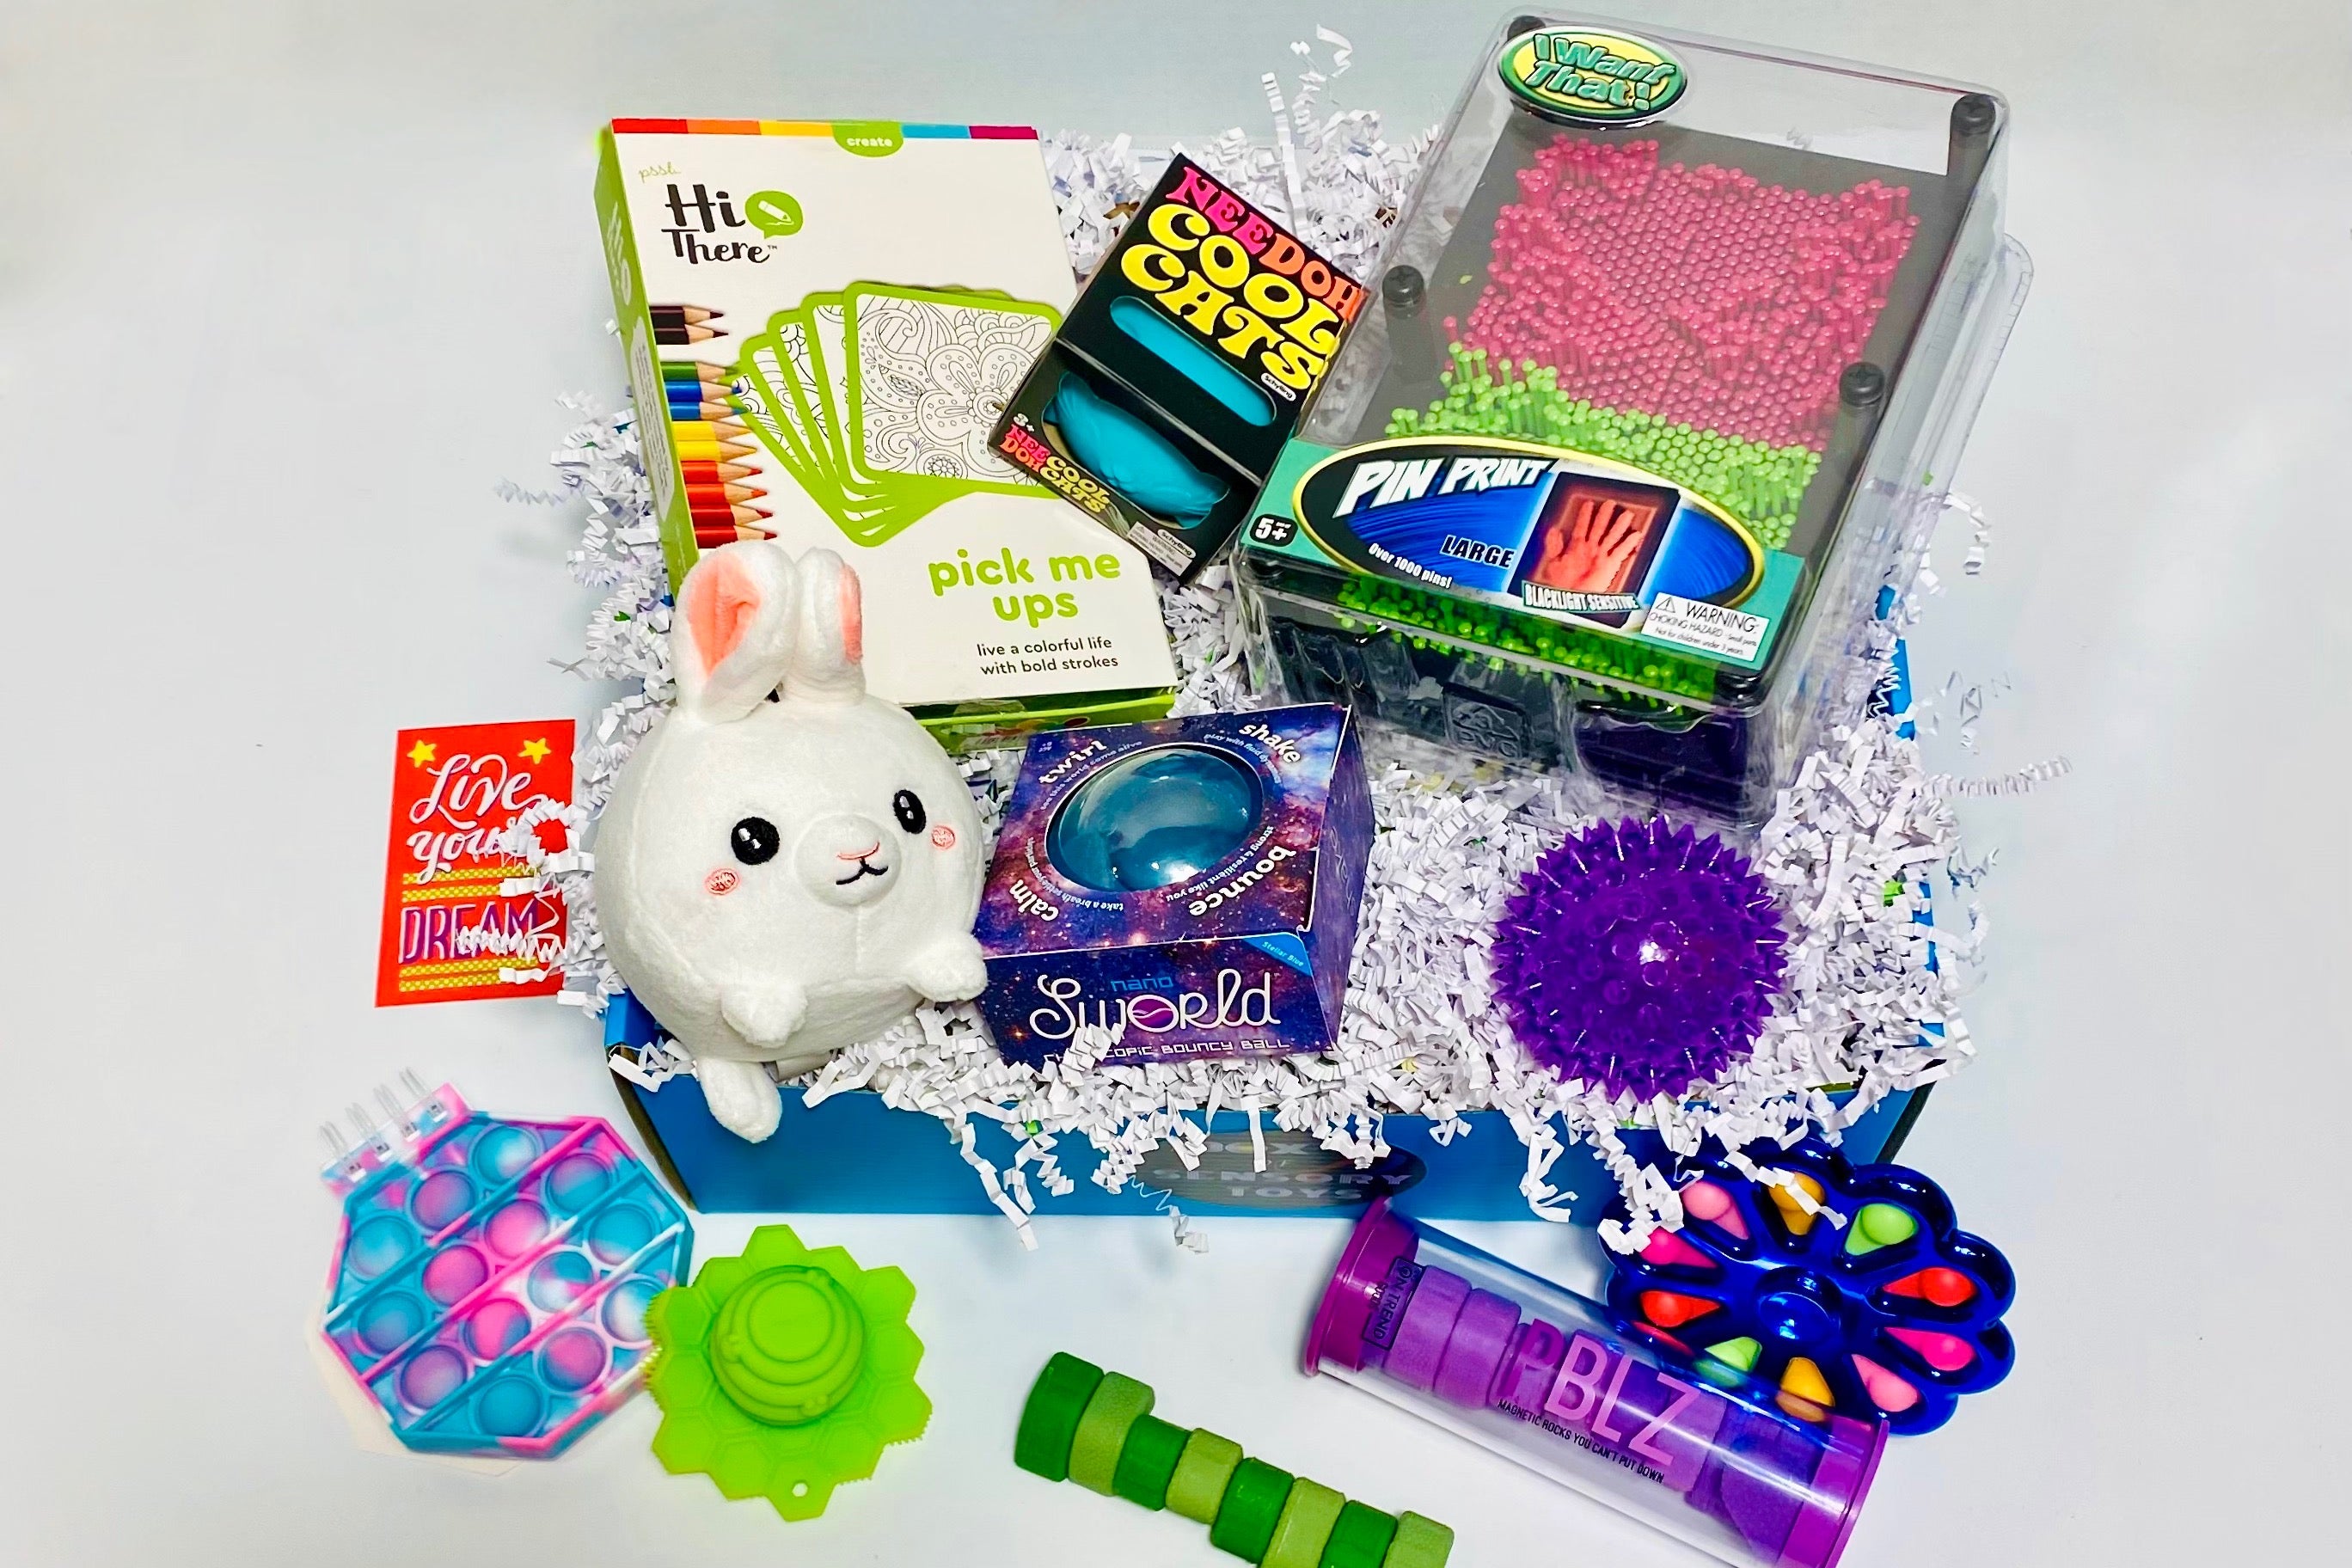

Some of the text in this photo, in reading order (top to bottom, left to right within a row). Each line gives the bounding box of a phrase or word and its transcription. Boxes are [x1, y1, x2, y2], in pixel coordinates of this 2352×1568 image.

[1533, 34, 1676, 85] I Want
[1524, 60, 1651, 111] That!
[846, 138, 893, 147] create
[665, 184, 745, 233] Hi
[1148, 204, 1340, 355] COOL
[1121, 244, 1324, 389] CATS
[1014, 413, 1035, 432] 3+
[999, 438, 1044, 473] DOH
[1039, 467, 1106, 513] CATS
[1046, 456, 1110, 505] COOL
[1332, 457, 1553, 518] PIN PRINT
[1369, 542, 1453, 589] Over 1000 pins!
[1440, 535, 1516, 570] LARGE
[928, 548, 1121, 597] pick me
[993, 592, 1079, 628] ups
[1525, 584, 1640, 611] BLACKLIGHT SENSITIVE
[1649, 612, 1688, 629] CHOKING
[1689, 622, 1723, 637] HAZARD
[1677, 632, 1701, 644] children
[1702, 640, 1720, 650] under
[977, 636, 1113, 657] live a colorful life
[980, 655, 1119, 676] with bold strokes
[1118, 741, 1142, 753] alive
[1238, 724, 1301, 763] shake
[1038, 740, 1107, 784] twirl
[409, 754, 548, 830] Live
[1249, 825, 1275, 852] strong
[1188, 845, 1297, 916] bounce
[1207, 855, 1248, 885] resilient
[1009, 879, 1059, 922] calm
[1061, 892, 1093, 909] breath
[1166, 891, 1188, 902] you
[1188, 883, 1210, 895] like
[1100, 903, 1124, 911] take
[1262, 940, 1305, 968] Stellar Blue
[1111, 975, 1175, 992] nano
[1161, 1040, 1234, 1054] BOUNCY
[1229, 1186, 1363, 1199] TOYS
[1374, 1265, 1413, 1340] ON TREND
[1498, 1318, 1700, 1467] PBLZ
[1498, 1399, 1665, 1484] MAGNETIC ROCKS YOU CAN'T PUT DOWN
